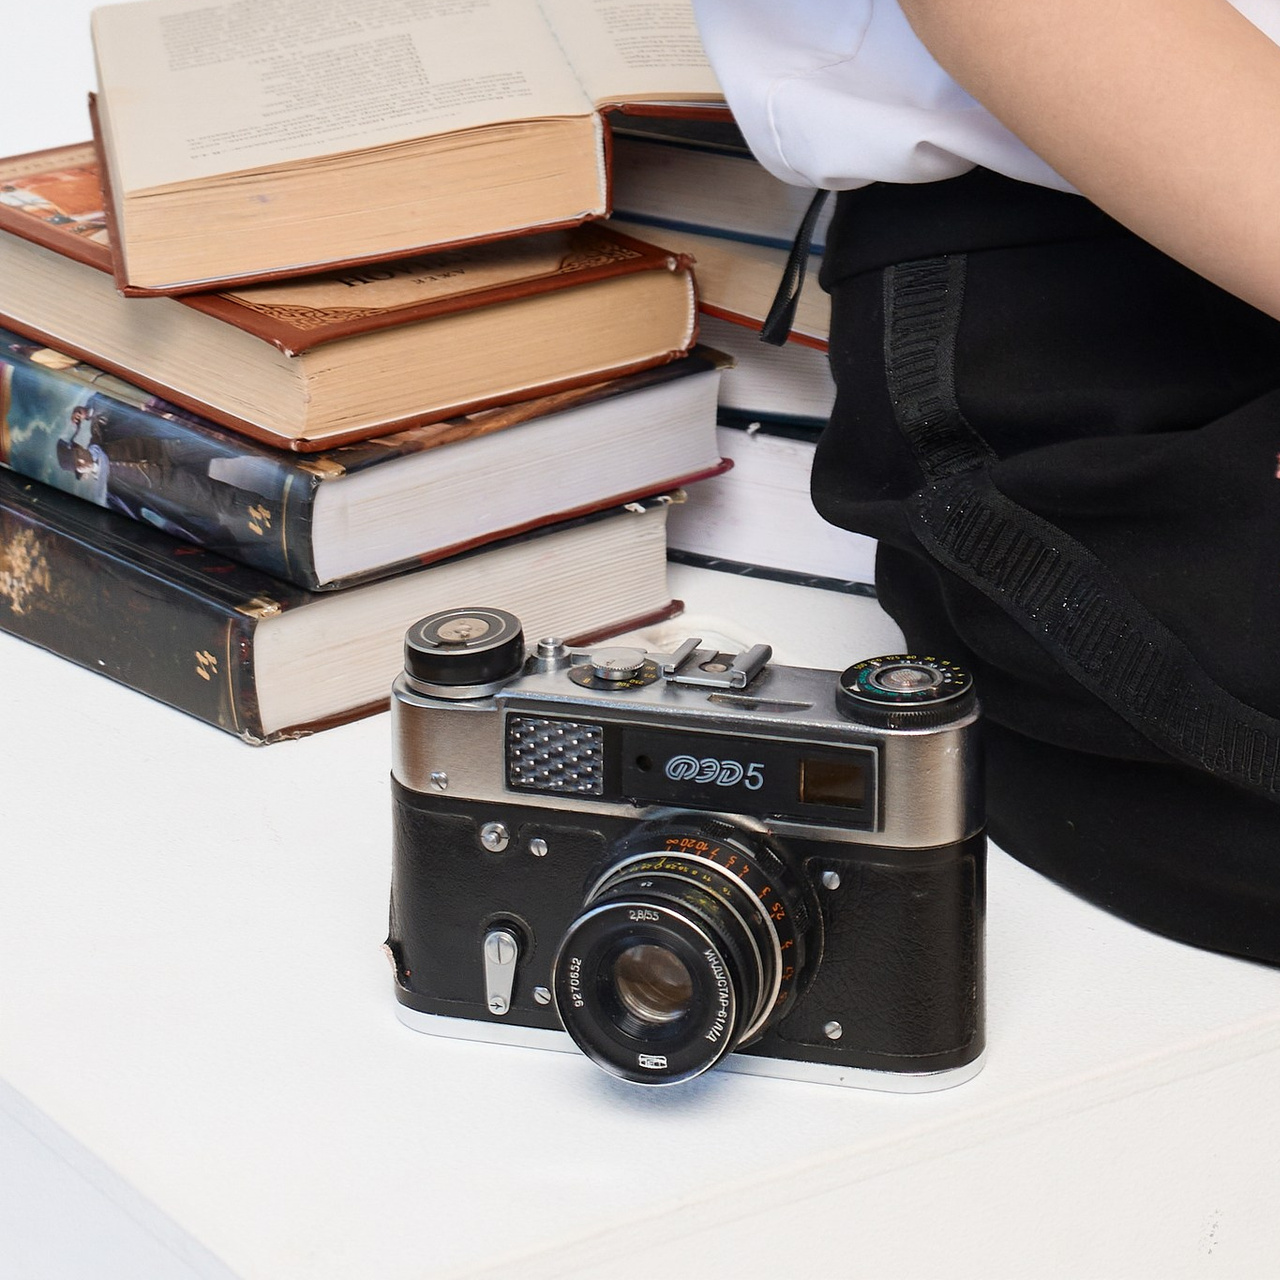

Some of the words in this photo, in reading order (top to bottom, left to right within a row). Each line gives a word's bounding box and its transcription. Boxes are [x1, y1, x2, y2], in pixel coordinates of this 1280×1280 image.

[680, 838, 695, 848] 20
[695, 840, 709, 851] 10
[728, 855, 738, 865] 5
[569, 957, 585, 1008] 9270652
